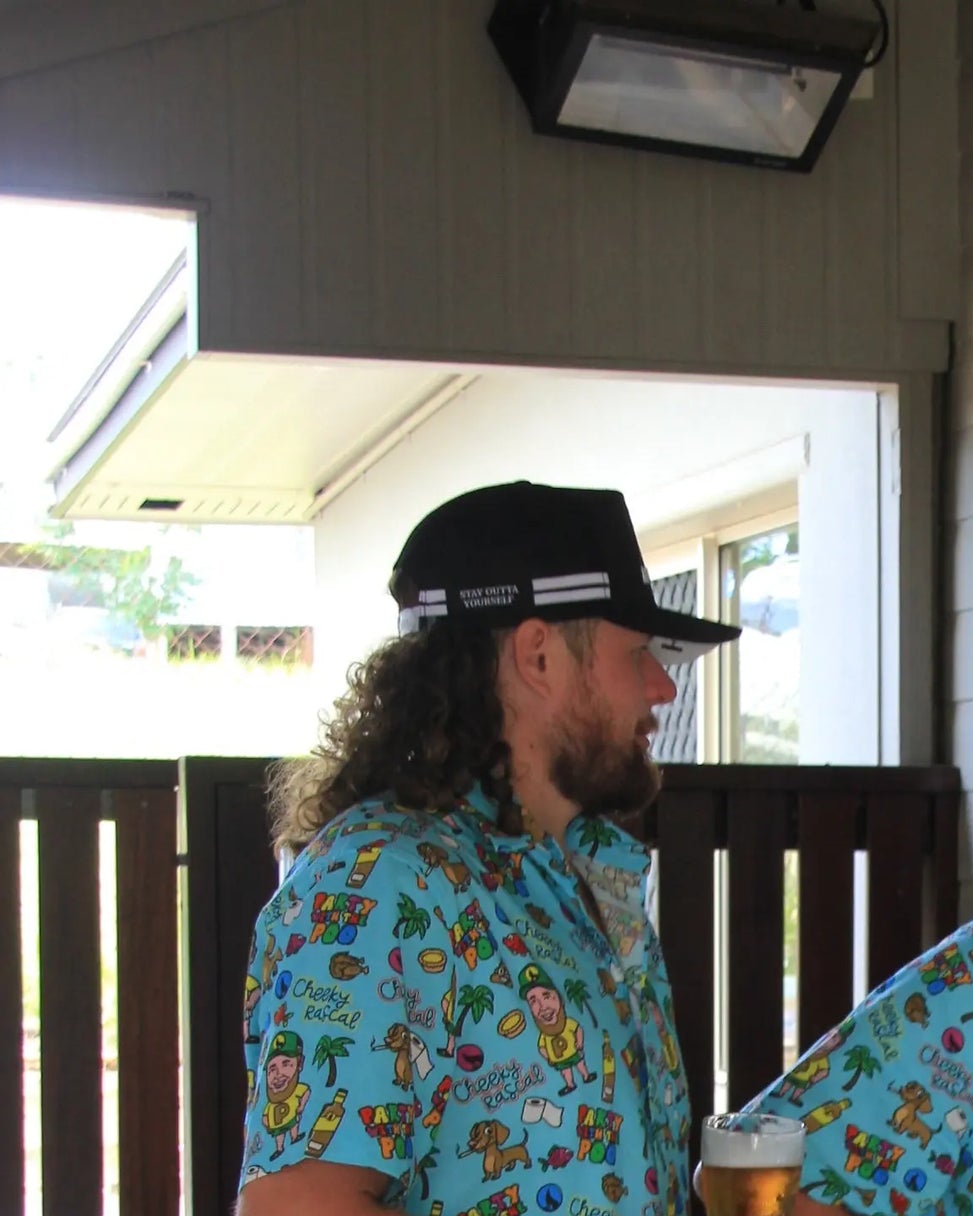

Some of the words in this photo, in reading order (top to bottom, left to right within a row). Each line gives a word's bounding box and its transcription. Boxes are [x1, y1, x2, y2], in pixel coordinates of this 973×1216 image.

[460, 588, 482, 599] STAY
[485, 584, 519, 596] OUTTA
[463, 594, 514, 608] YOURSELF
[314, 892, 377, 914] PARTY
[309, 923, 357, 944] POO
[293, 979, 351, 1007] Cheeky
[452, 1060, 522, 1102] Cheeky
[578, 1104, 623, 1132] PARTY
[577, 1138, 617, 1166] POO
